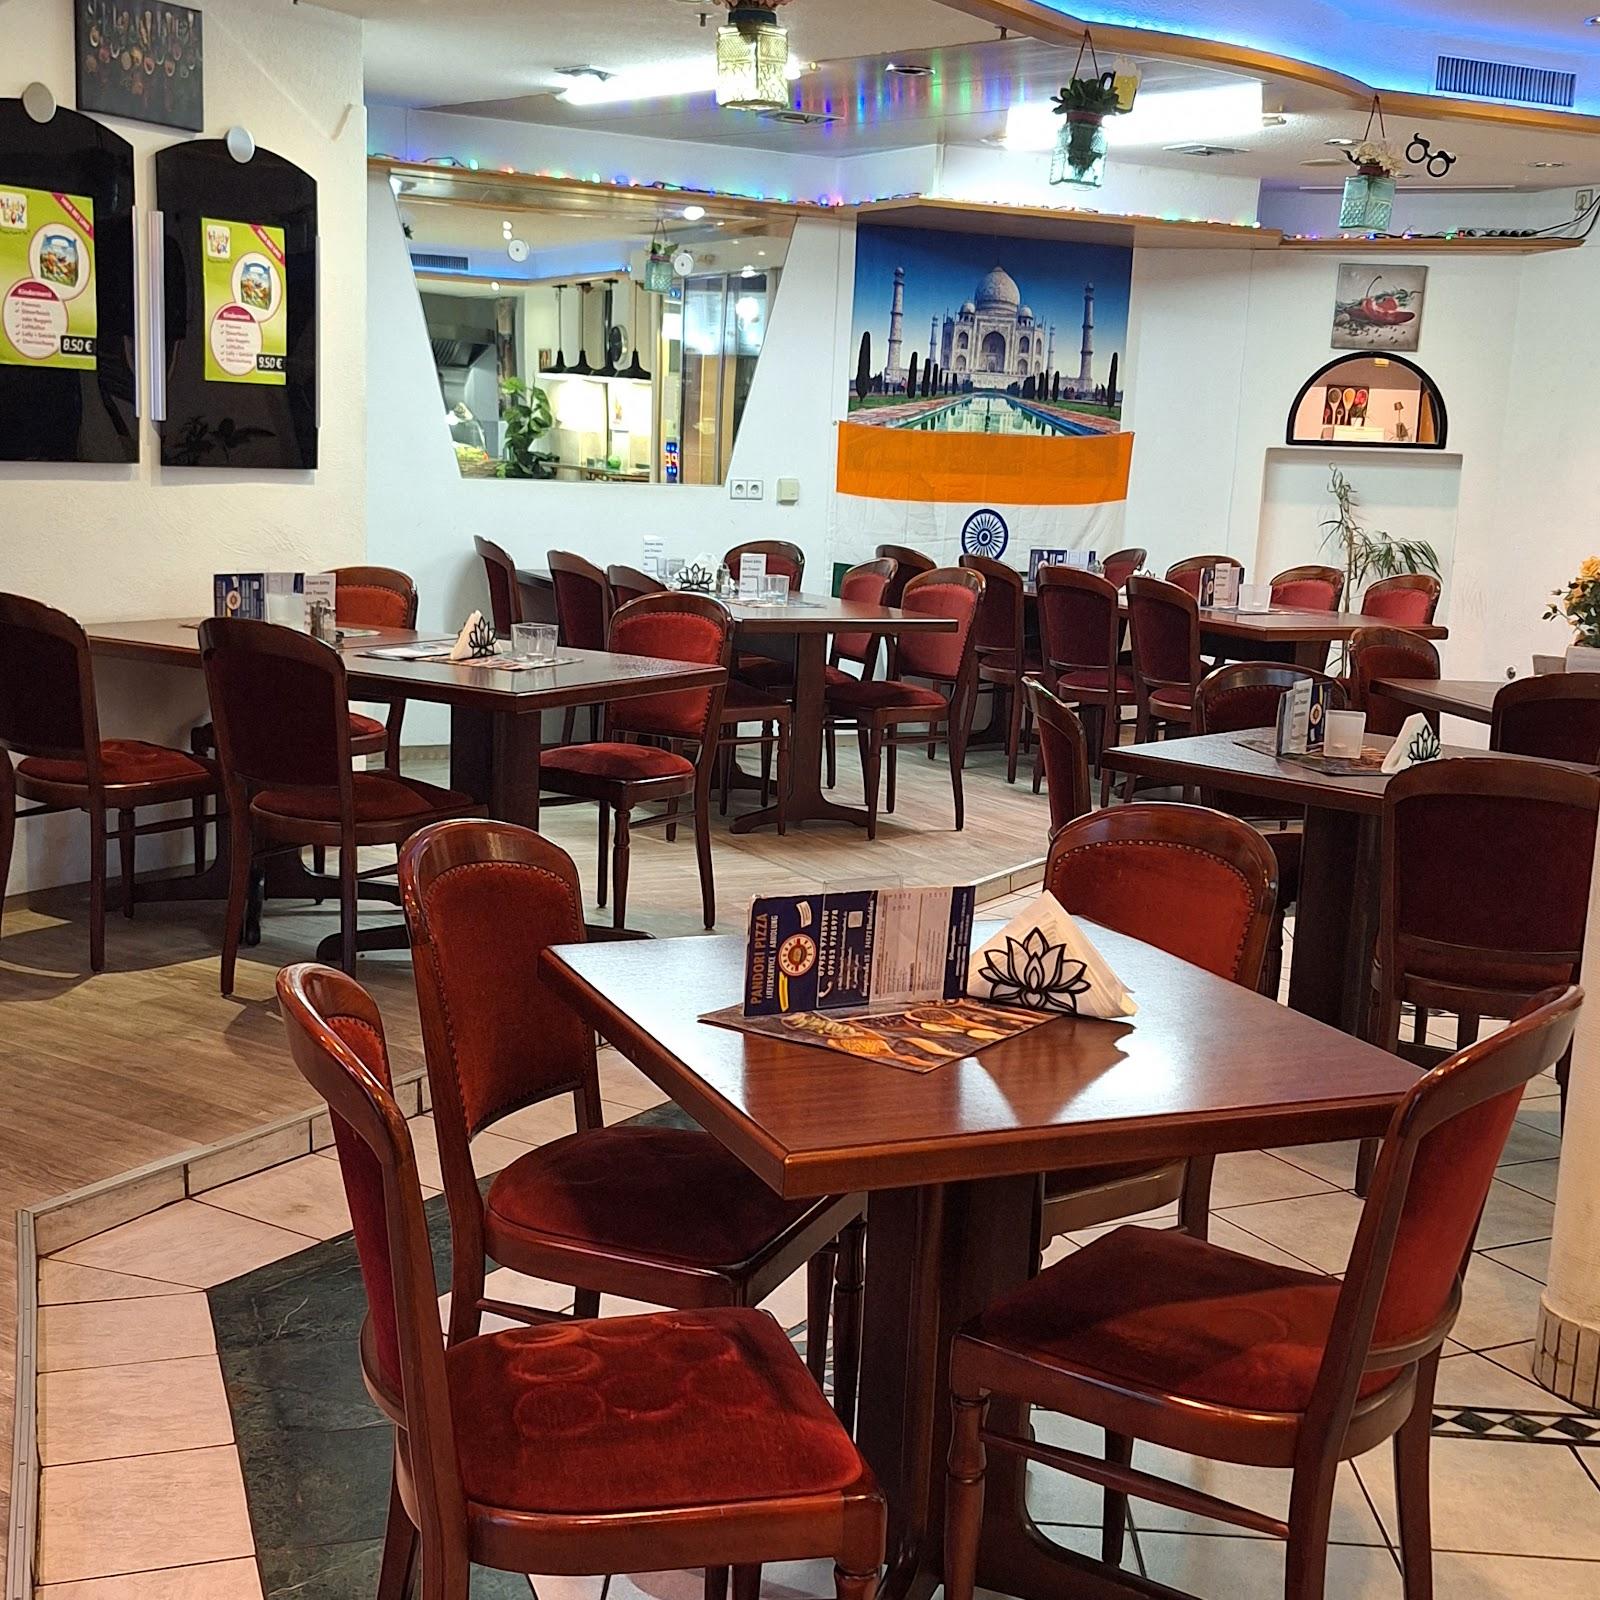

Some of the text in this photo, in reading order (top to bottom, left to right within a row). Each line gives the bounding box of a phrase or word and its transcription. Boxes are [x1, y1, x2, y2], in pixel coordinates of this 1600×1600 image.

[85, 341, 93, 353] €
[276, 358, 283, 369] €
[751, 913, 768, 1004] PANDORI PIZZA
